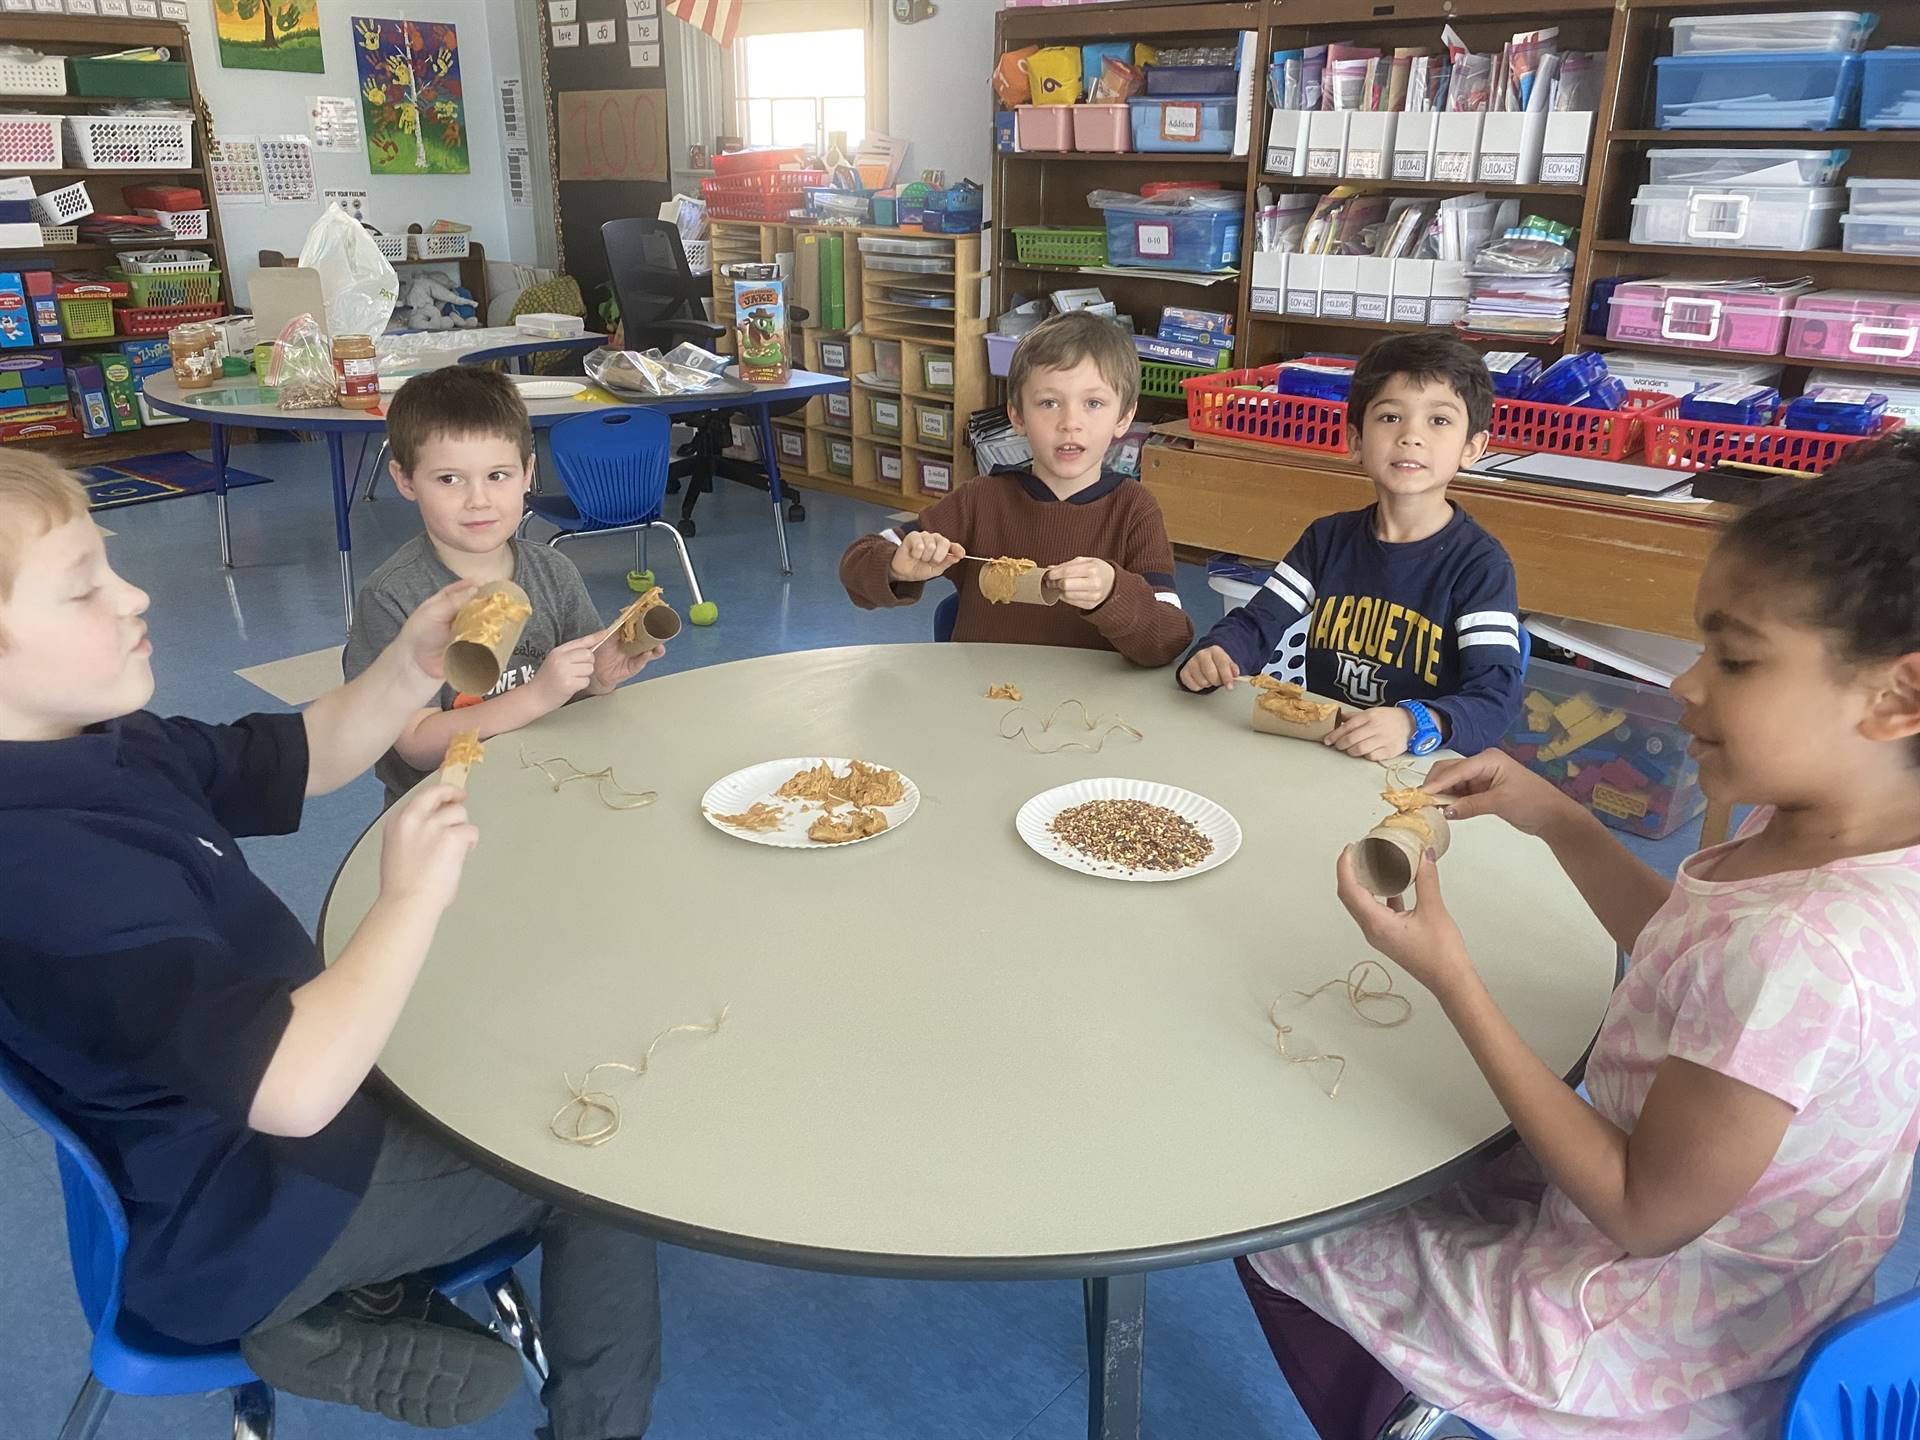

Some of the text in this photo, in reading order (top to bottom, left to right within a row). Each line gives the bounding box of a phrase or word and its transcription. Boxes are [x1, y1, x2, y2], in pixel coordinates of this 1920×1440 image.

[560, 5, 569, 18] to
[558, 29, 572, 41] love
[638, 24, 650, 37] he
[643, 52, 649, 61] a
[1168, 119, 1194, 129] Addition
[568, 93, 658, 177] 100
[1147, 236, 1161, 245] 0-10
[743, 293, 773, 306] JAKE
[1150, 344, 1193, 359] Bingo Bears
[1633, 377, 1669, 388] Wonders
[488, 669, 517, 695] NE
[1337, 655, 1384, 705] MU
